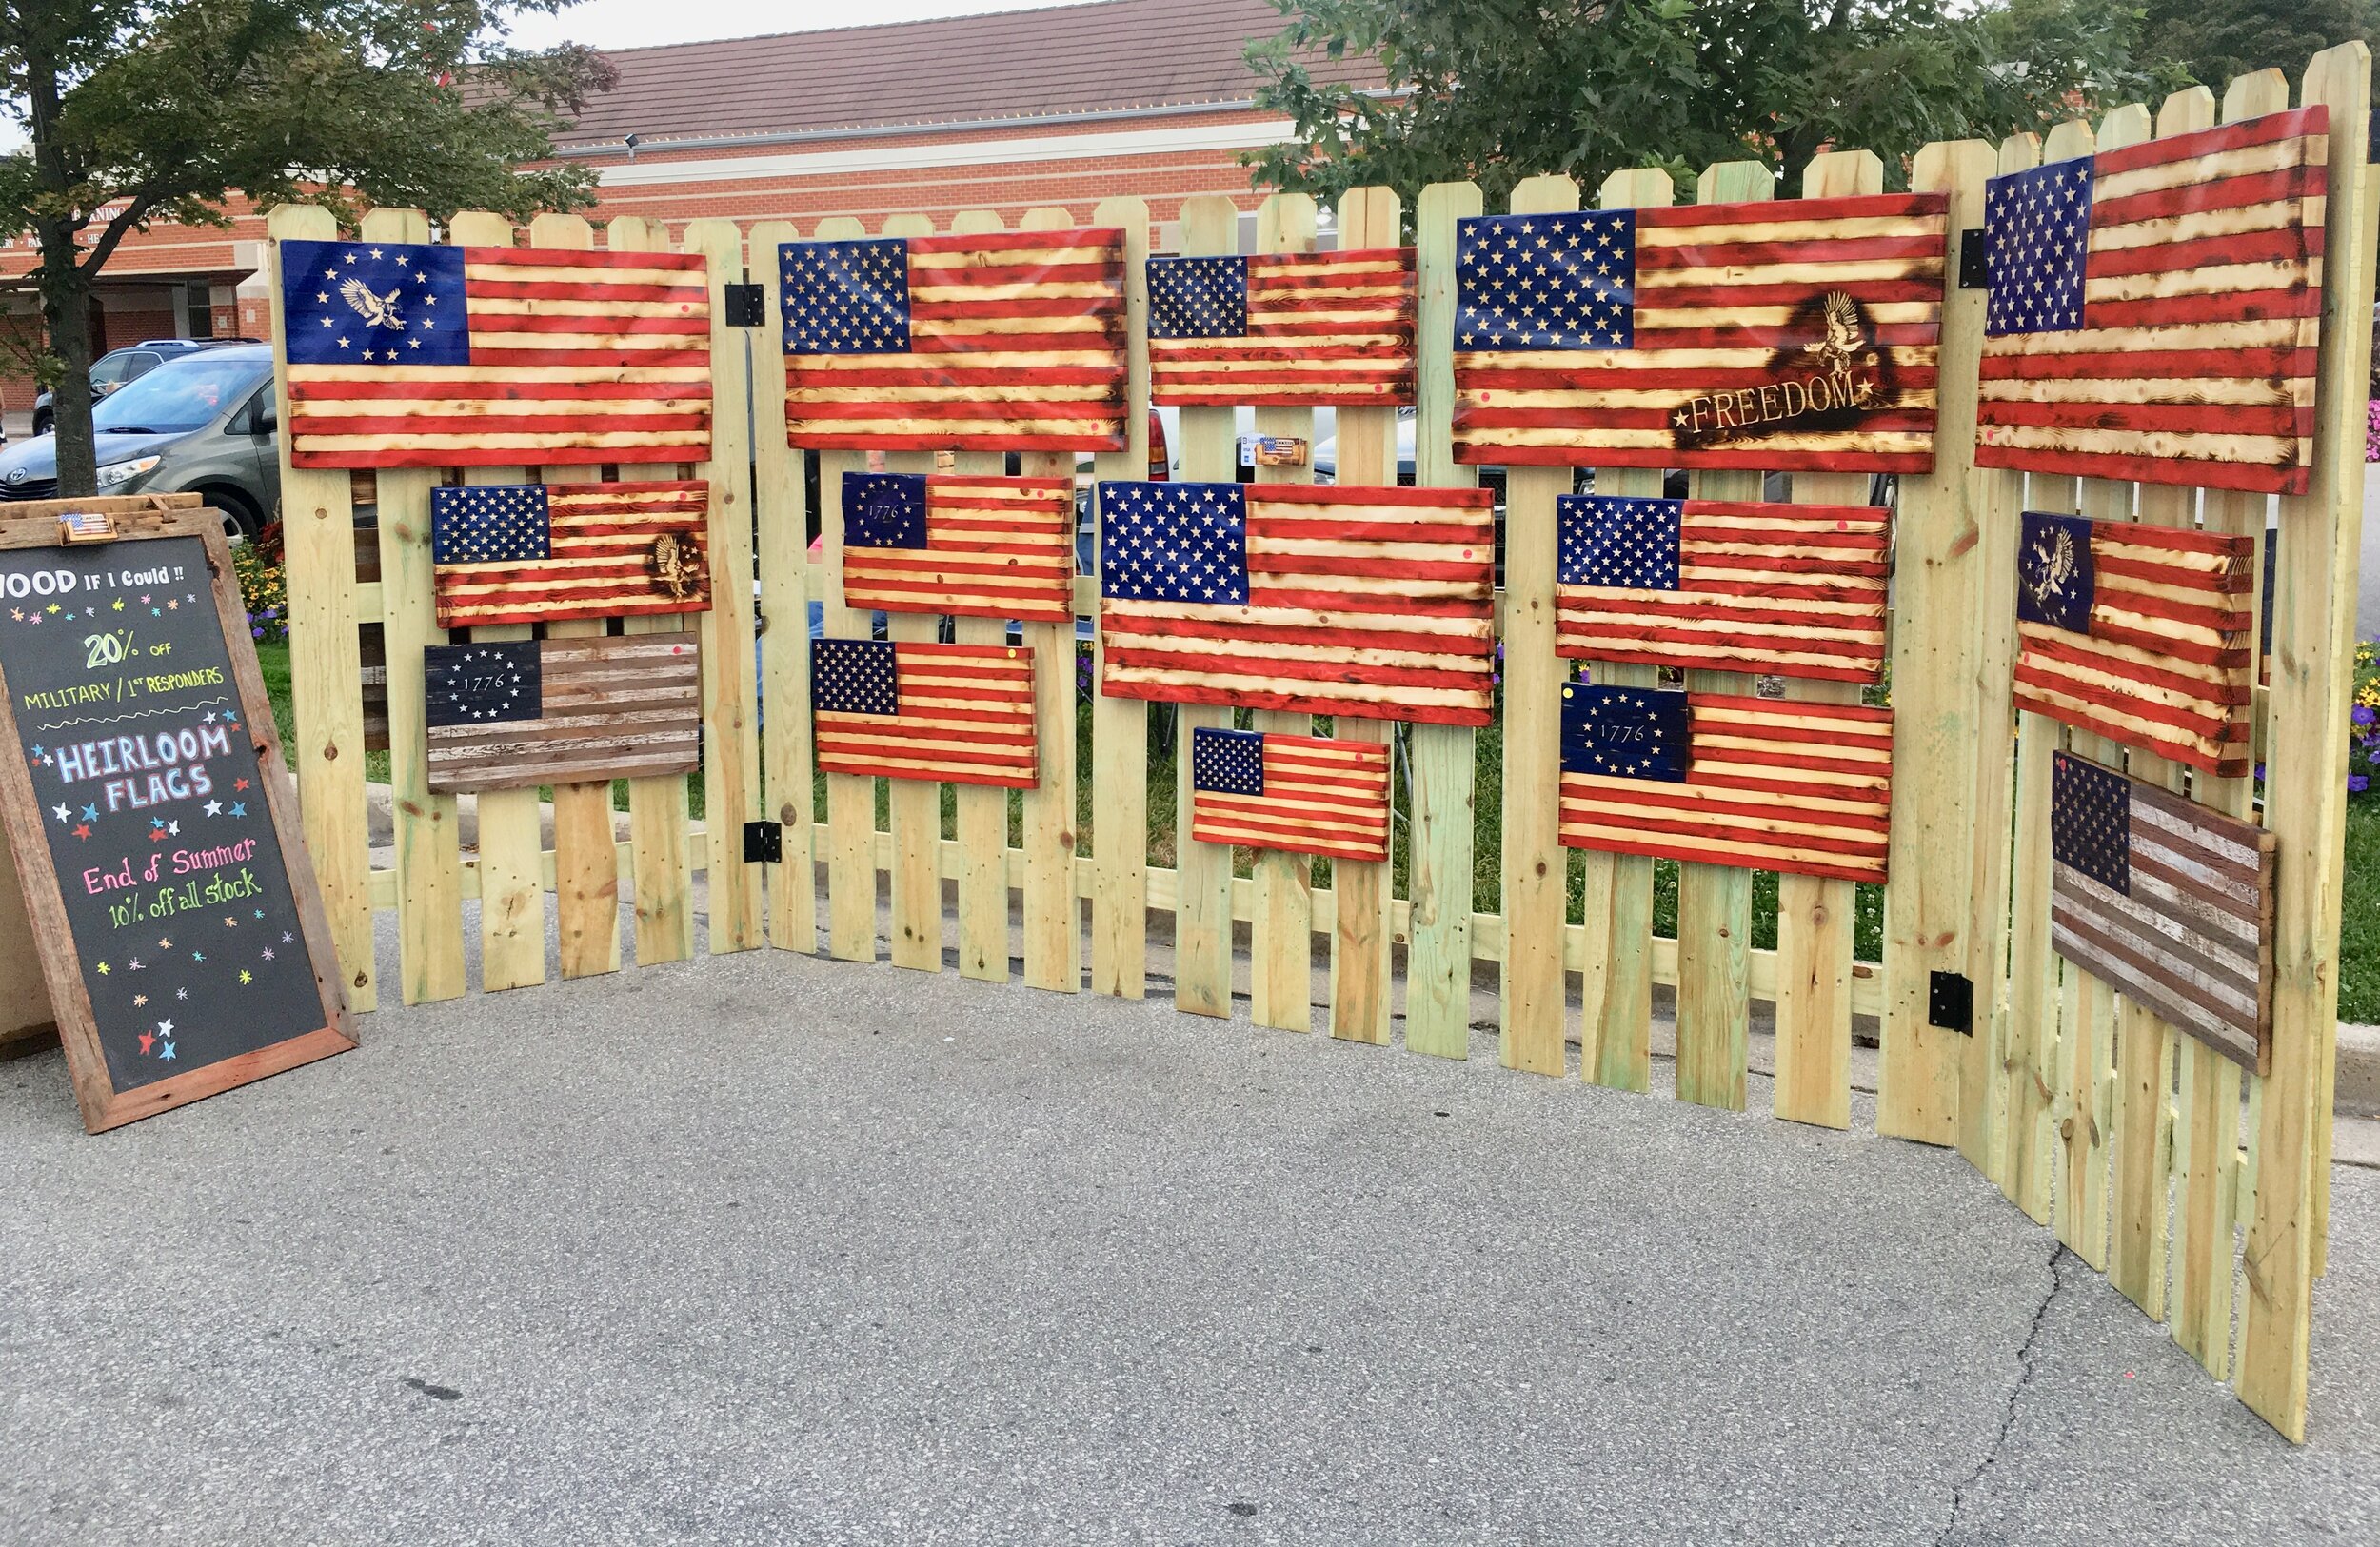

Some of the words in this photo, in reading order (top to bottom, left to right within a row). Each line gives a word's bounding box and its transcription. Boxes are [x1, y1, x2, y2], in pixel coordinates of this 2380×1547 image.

[1690, 370, 1857, 434] FREEDOM
[868, 504, 899, 520] 1776
[84, 574, 101, 591] IF
[108, 572, 116, 587] I
[121, 566, 170, 587] Could
[83, 628, 139, 670] 20%
[149, 642, 172, 657] OFF
[24, 682, 111, 710] MILITARY
[146, 666, 225, 693] RESPONDERS
[464, 673, 505, 692] 1776
[54, 724, 232, 783] HEIRLOOM
[1600, 724, 1645, 743] 1776
[104, 763, 213, 812] FLAGS
[83, 857, 138, 895] End
[144, 852, 162, 883] of
[172, 837, 256, 874] Summer
[109, 892, 144, 929] 10%
[149, 887, 176, 918] off
[178, 880, 204, 911] all
[205, 867, 263, 905] stock
